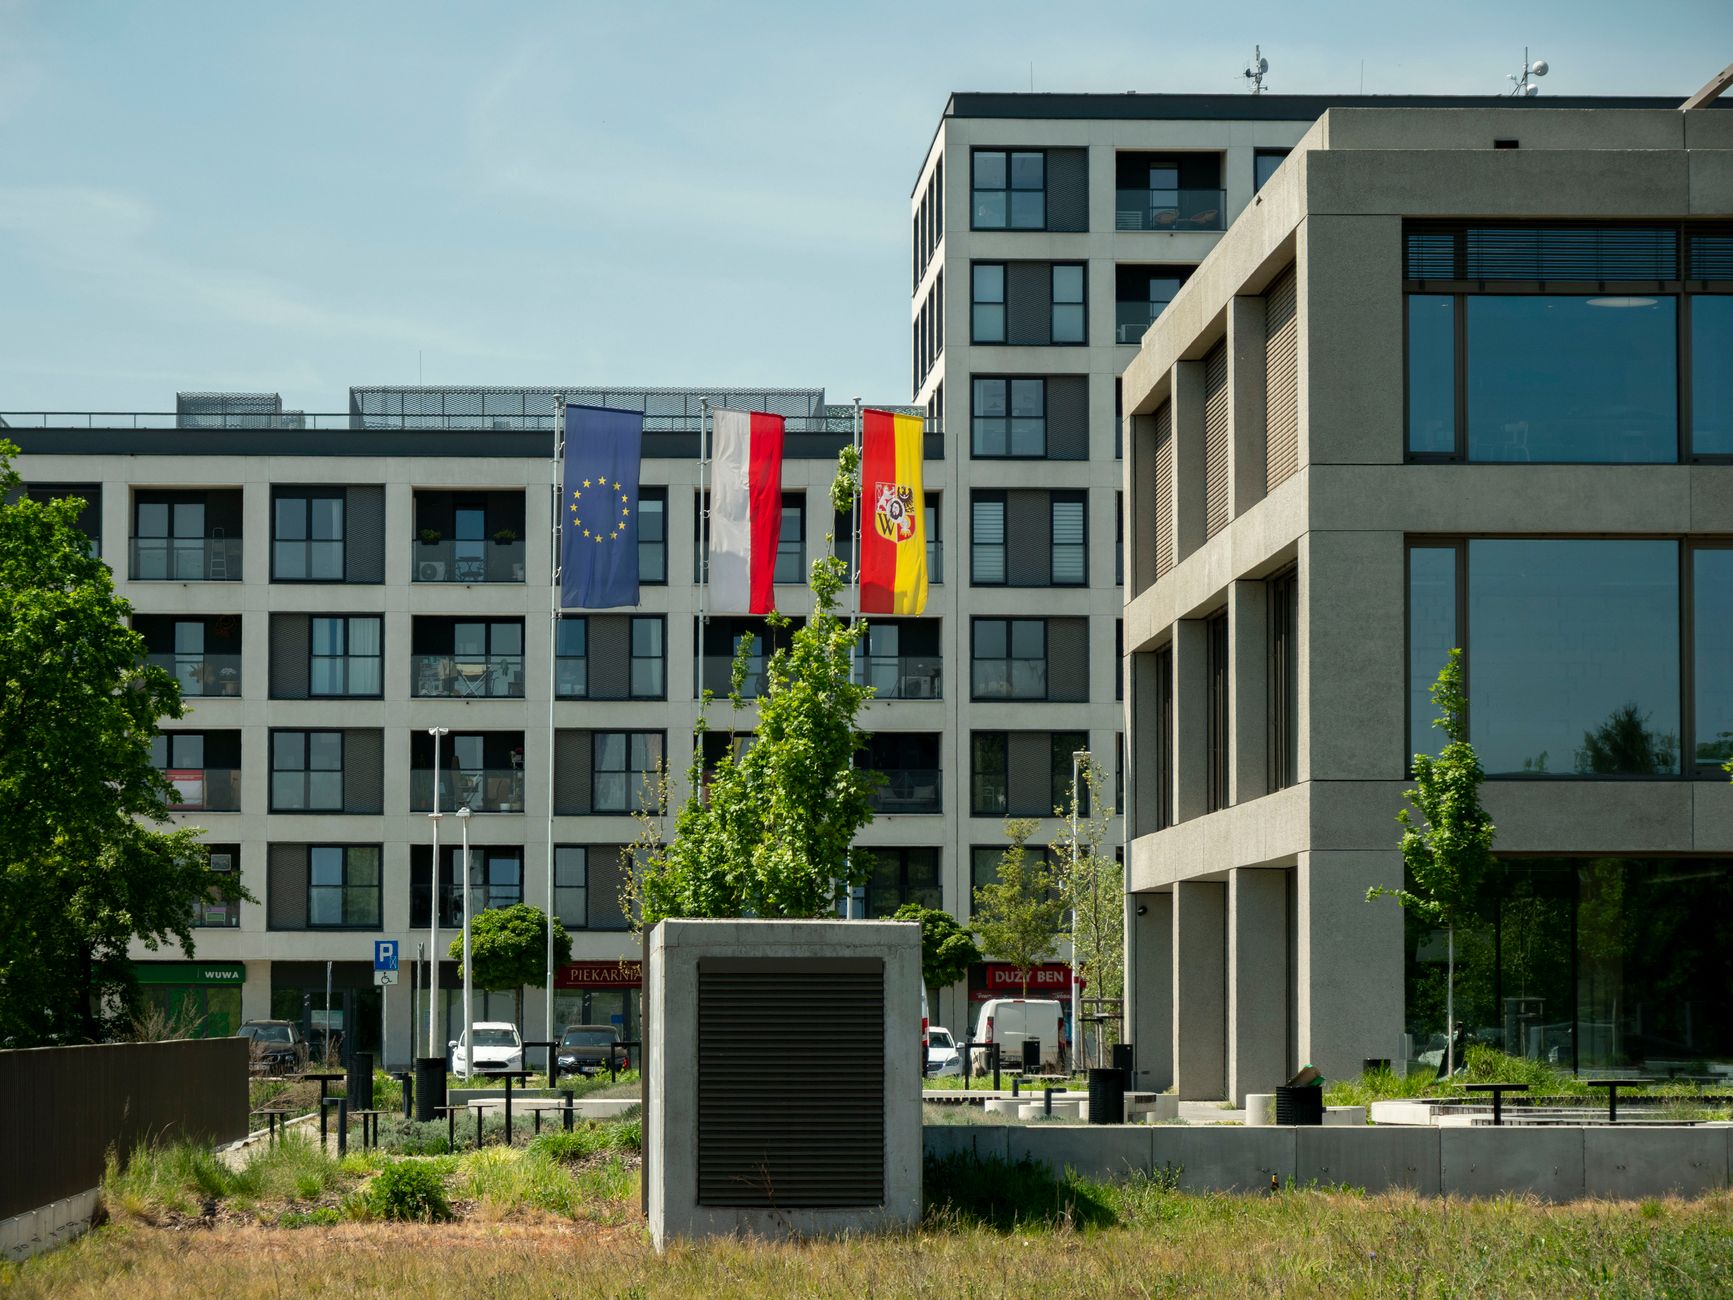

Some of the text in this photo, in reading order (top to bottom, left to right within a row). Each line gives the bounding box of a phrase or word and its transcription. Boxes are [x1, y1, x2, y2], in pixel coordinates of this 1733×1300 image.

[379, 943, 394, 962] P
[204, 971, 240, 979] WUWA
[570, 969, 643, 981] PIEKARNIA
[1037, 971, 1064, 983] BEN
